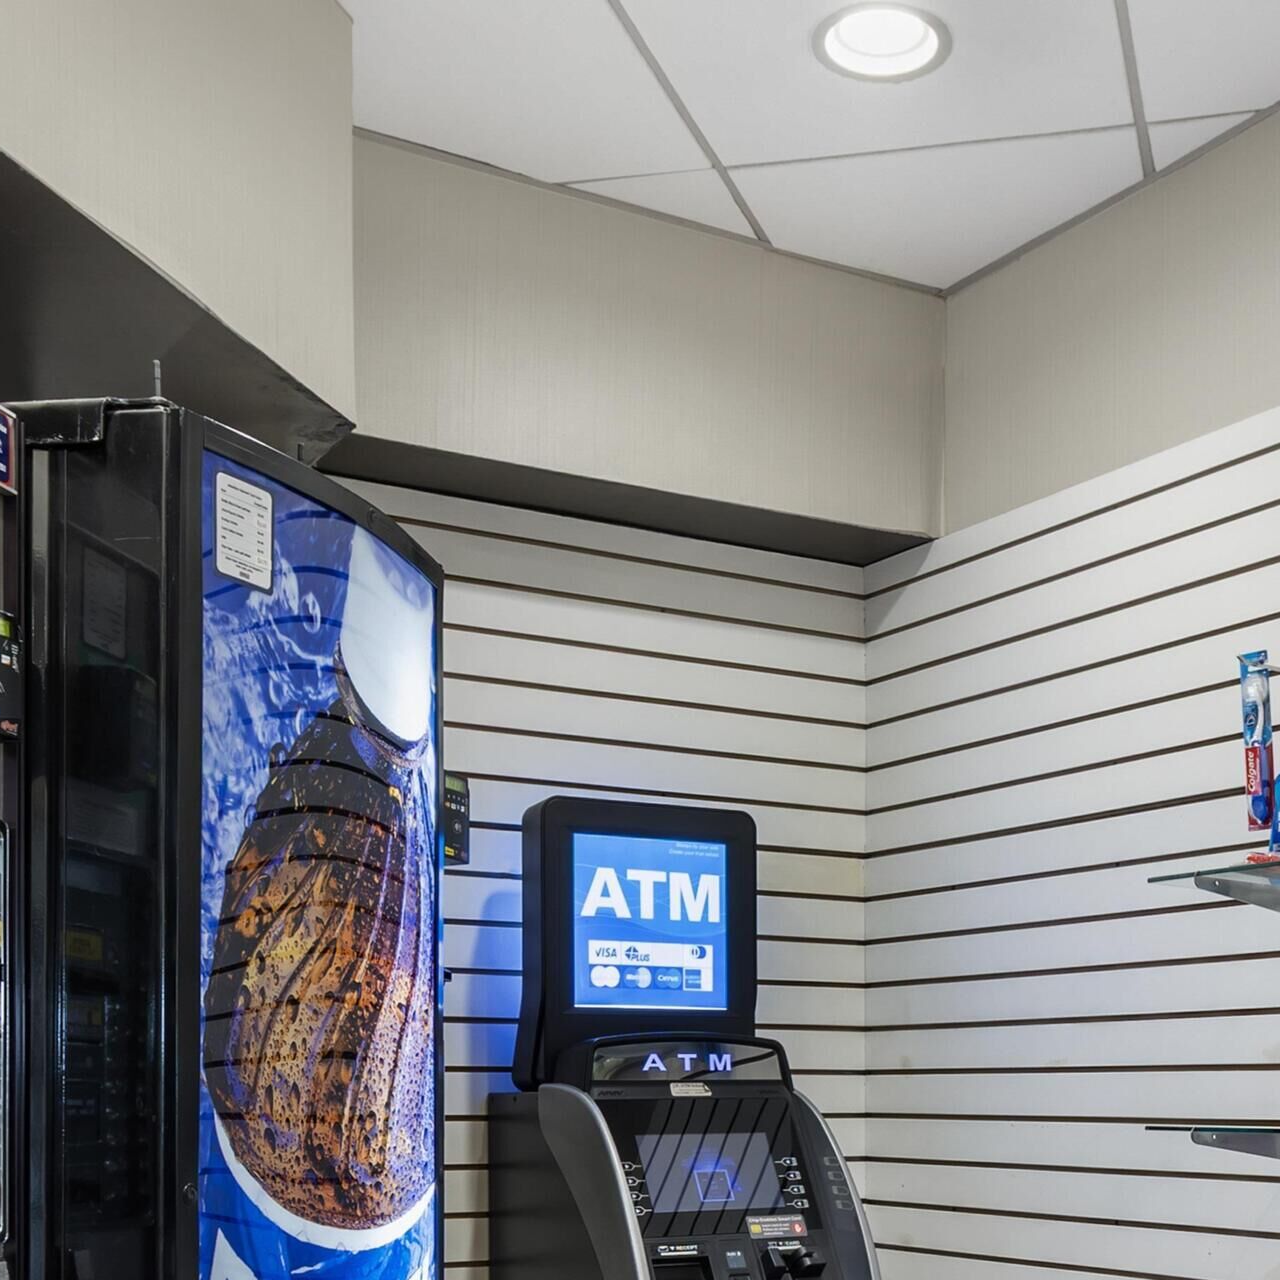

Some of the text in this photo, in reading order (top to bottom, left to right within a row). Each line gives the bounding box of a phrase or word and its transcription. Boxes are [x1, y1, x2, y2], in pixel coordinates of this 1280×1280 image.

[1247, 750, 1256, 793] Colgate
[580, 866, 721, 924] ATM
[595, 947, 618, 958] VISA
[631, 953, 651, 963] PLUS
[642, 1052, 733, 1073] ATM
